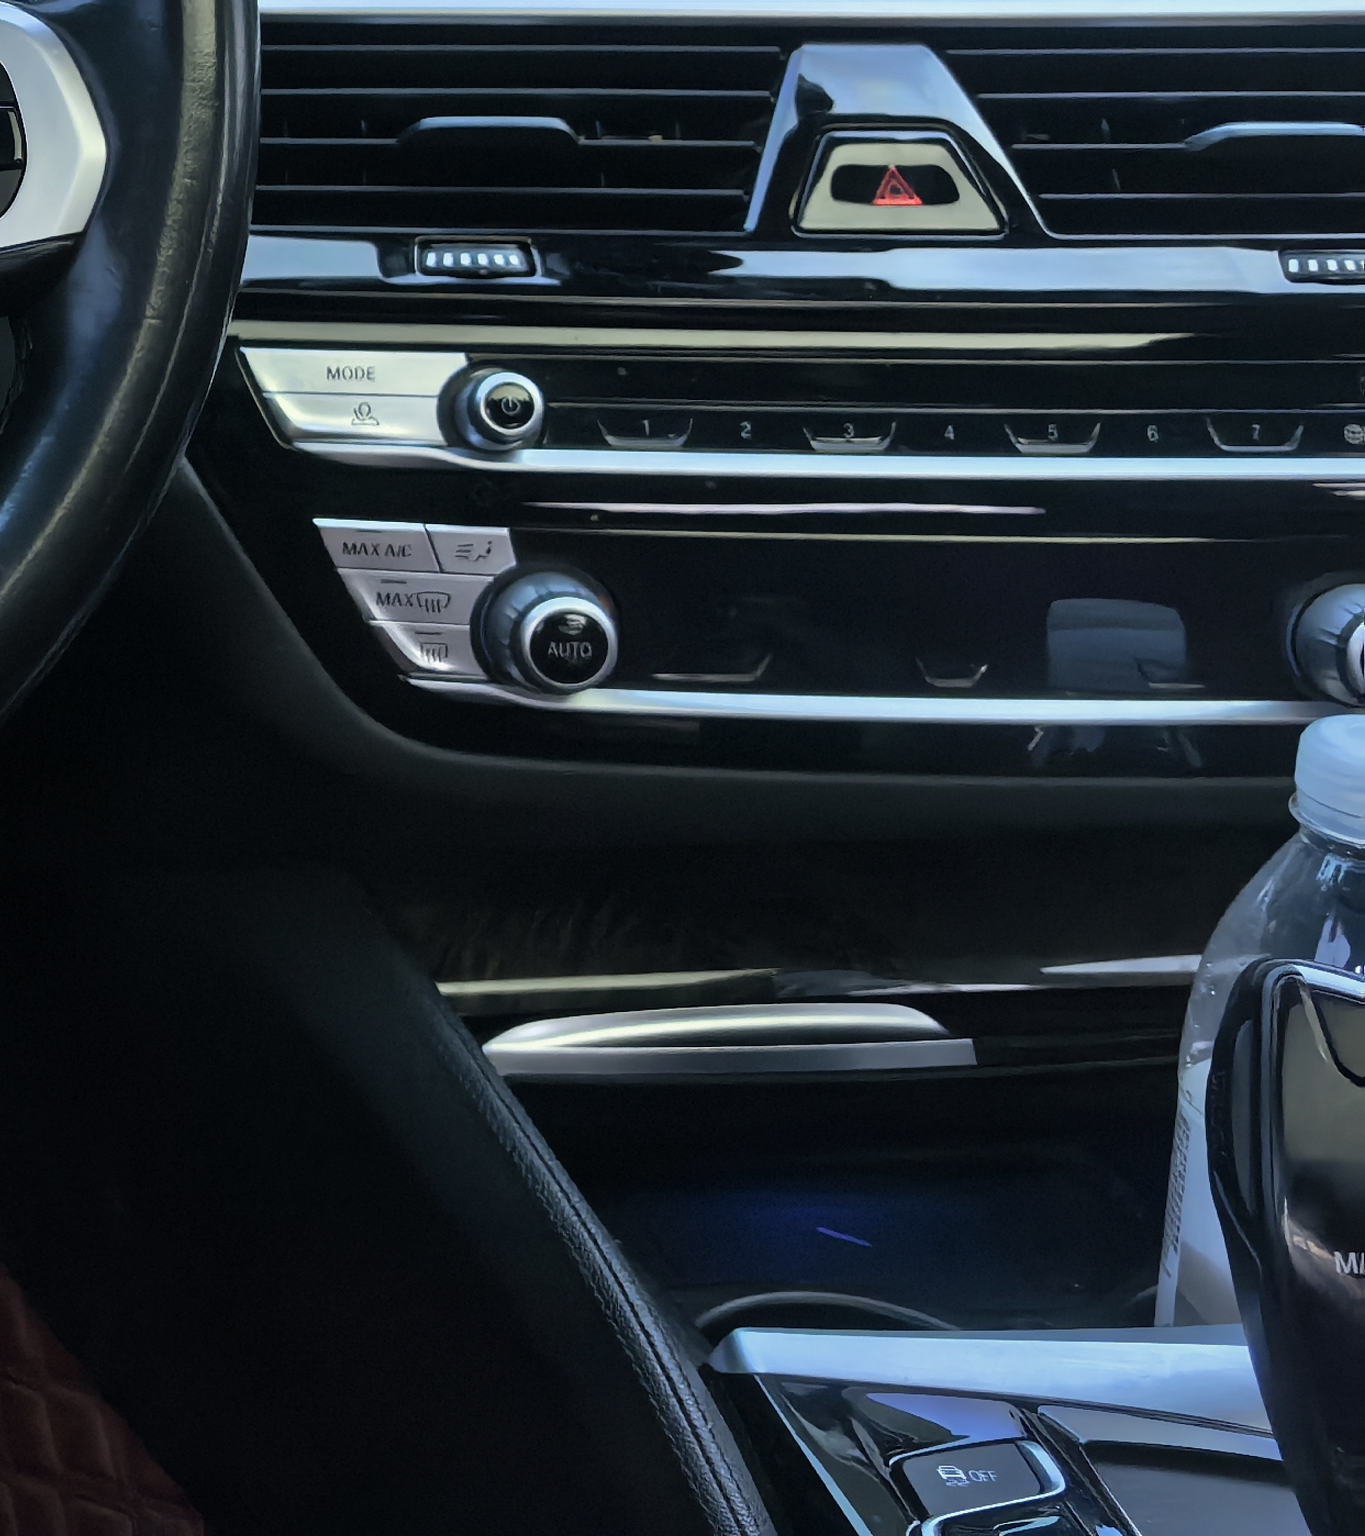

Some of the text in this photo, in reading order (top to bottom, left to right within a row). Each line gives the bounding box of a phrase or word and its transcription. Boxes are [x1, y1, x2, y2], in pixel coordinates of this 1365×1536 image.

[326, 366, 376, 382] MODE
[641, 419, 1261, 442] 1 2 3 4 5 6 7
[342, 542, 414, 558] MAX A/C
[375, 591, 415, 608] MAX
[547, 641, 593, 659] AUTO
[969, 1470, 997, 1482] OFF
